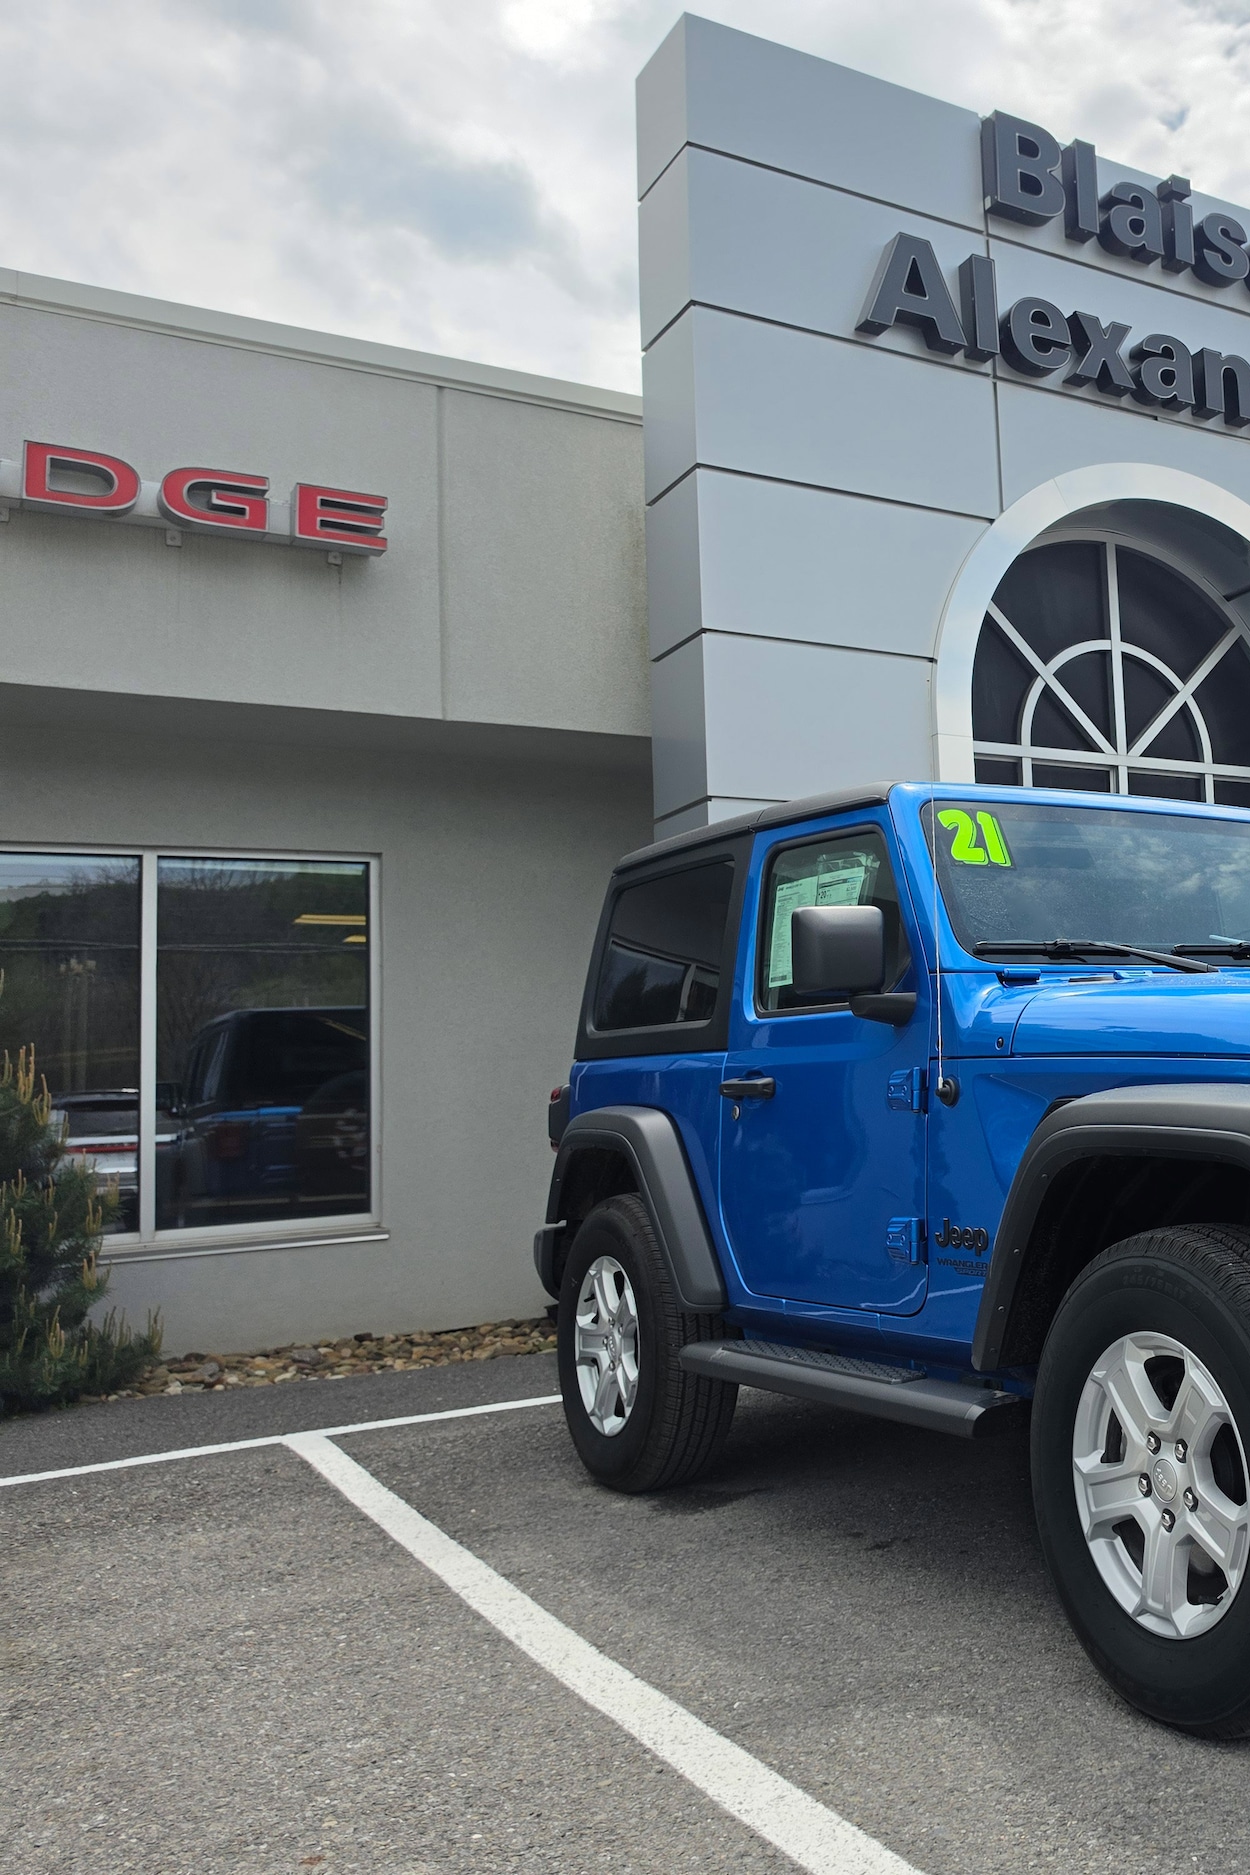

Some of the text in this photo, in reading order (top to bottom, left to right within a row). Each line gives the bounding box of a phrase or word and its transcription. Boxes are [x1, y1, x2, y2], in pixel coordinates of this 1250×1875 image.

[937, 808, 1012, 867] 21
[935, 1217, 990, 1257] Jeep
[936, 1257, 989, 1269] WRANGLER
